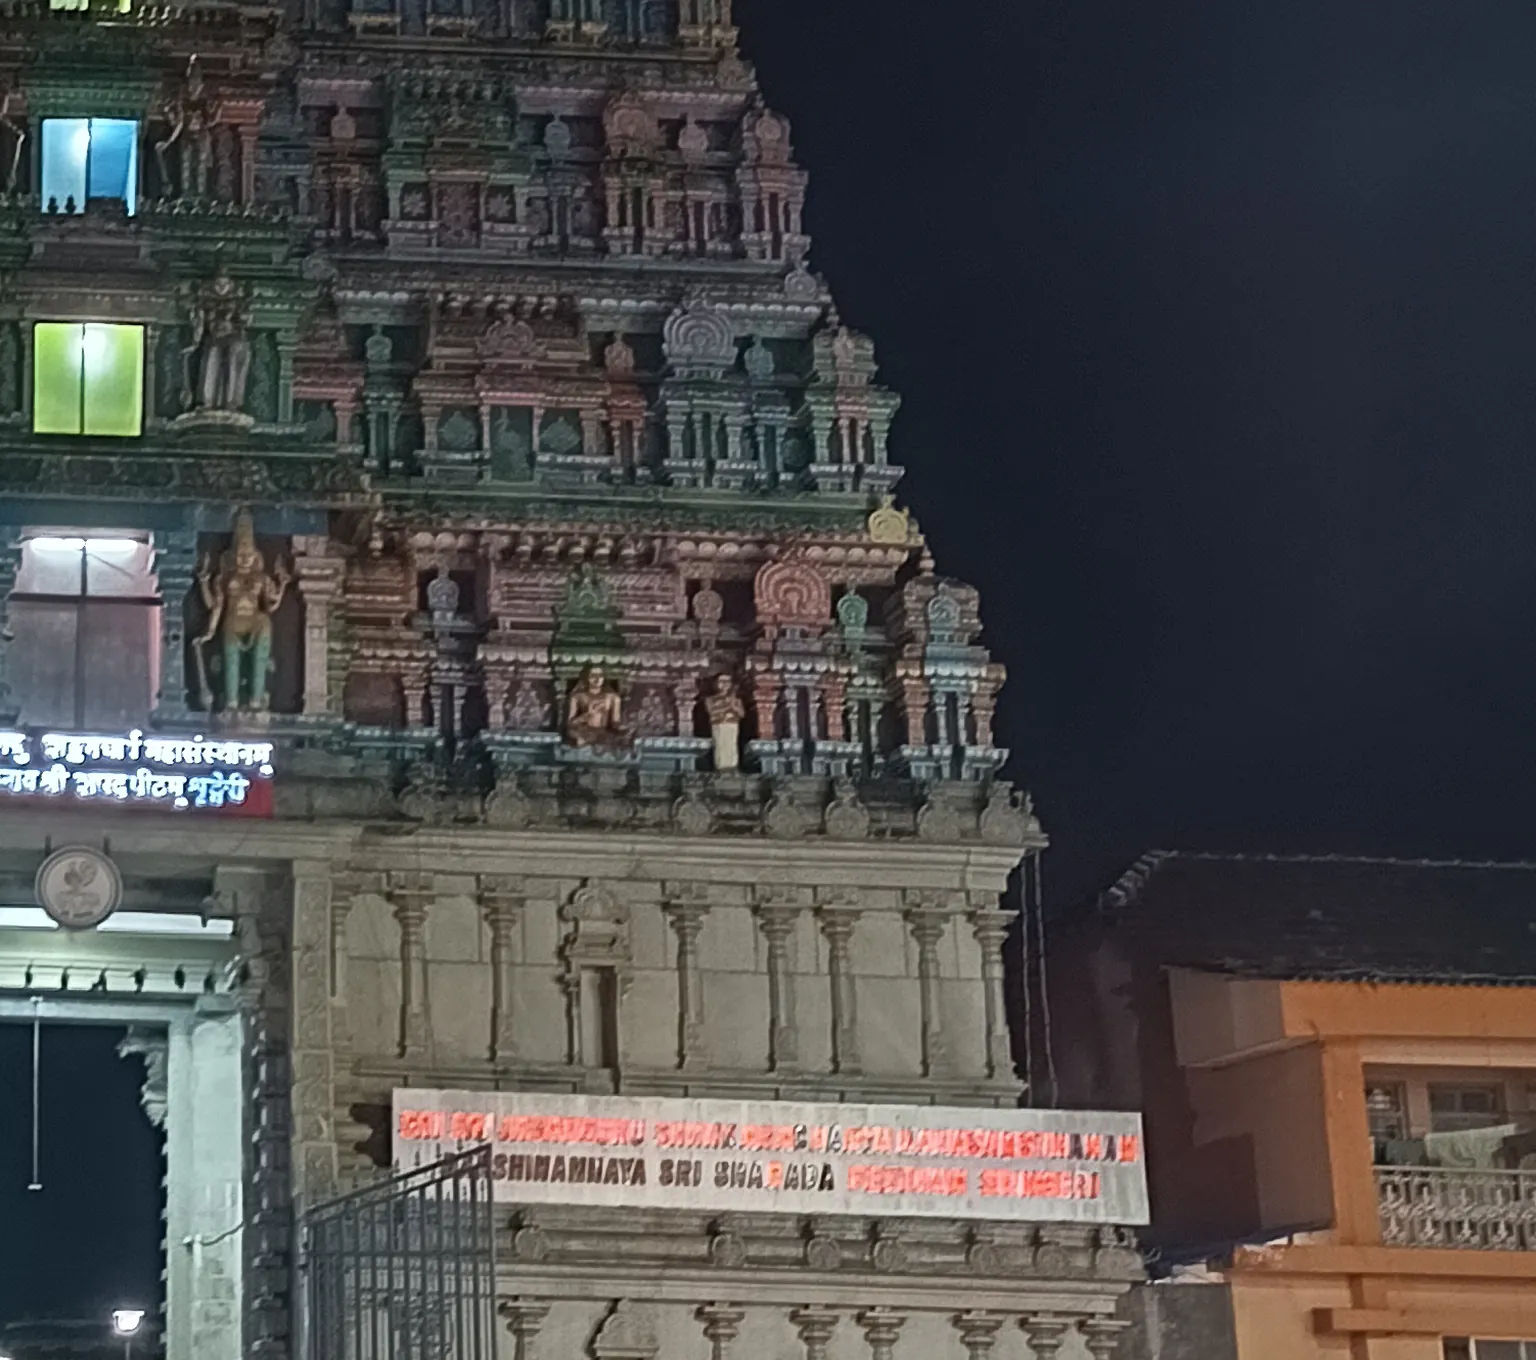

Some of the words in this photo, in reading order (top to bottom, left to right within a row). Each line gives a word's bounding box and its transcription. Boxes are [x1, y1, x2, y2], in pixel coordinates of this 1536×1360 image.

[39, 763, 71, 795] श्री
[398, 1109, 445, 1140] SRI
[451, 1111, 494, 1141] SRI
[659, 1158, 703, 1188] SRI
[713, 1160, 836, 1192] SHARADA
[978, 1167, 1102, 1201] SRINGERI
